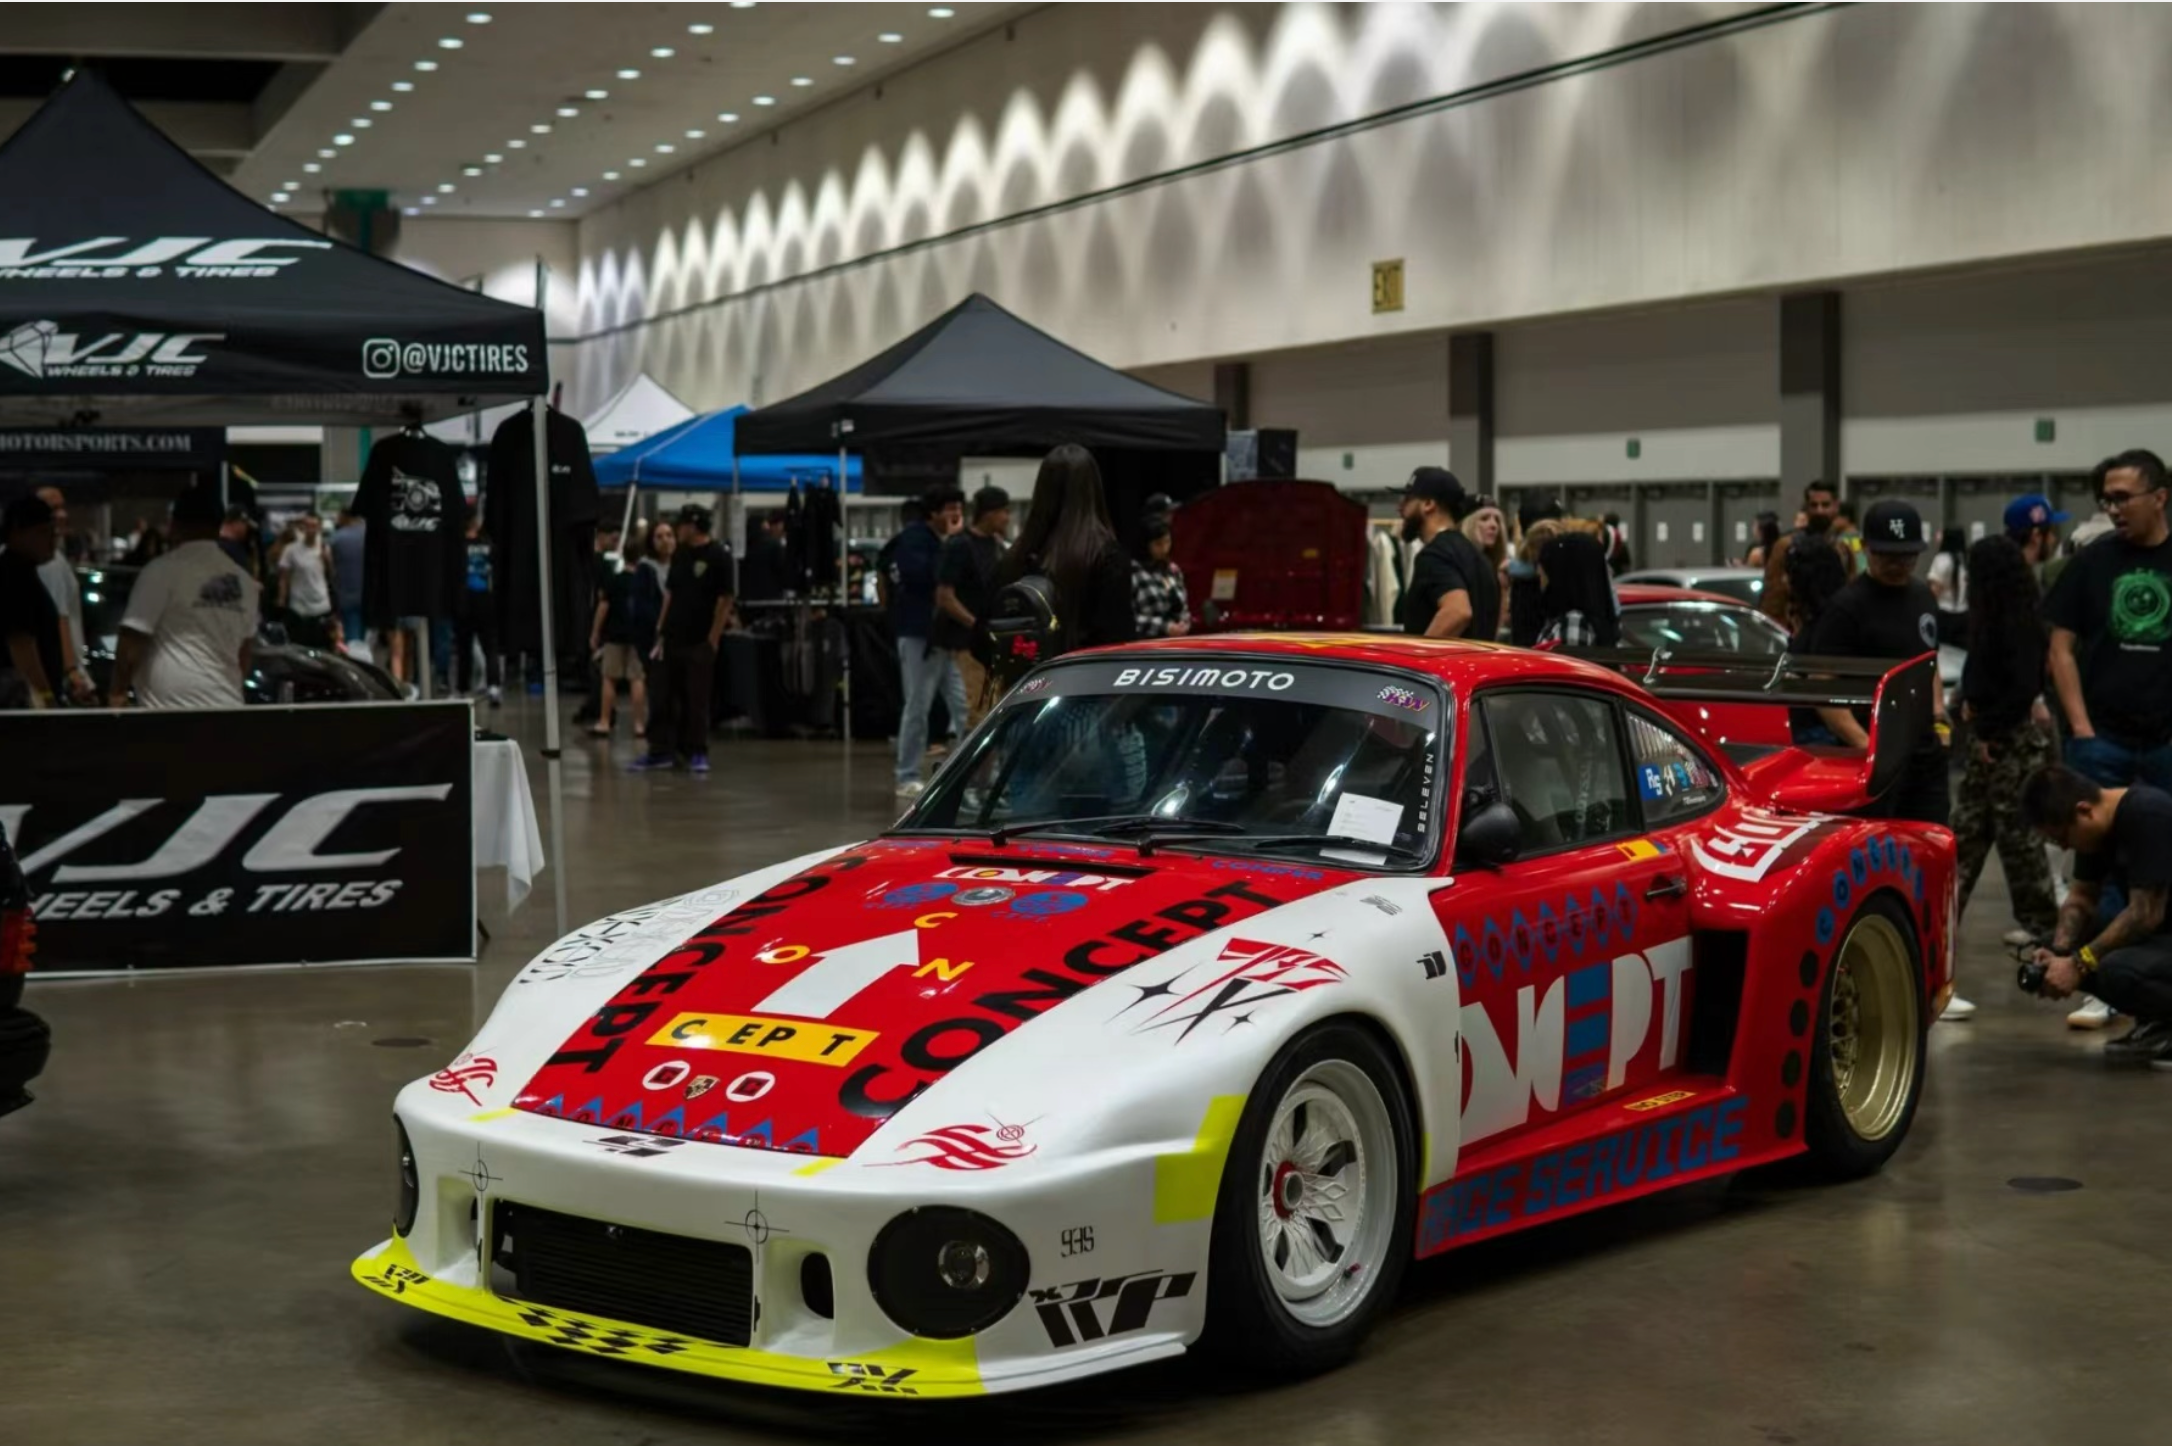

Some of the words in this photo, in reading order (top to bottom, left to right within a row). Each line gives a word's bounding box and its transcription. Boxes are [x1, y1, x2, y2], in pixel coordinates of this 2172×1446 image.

[175, 266, 278, 277] TIRES
[44, 333, 226, 363] VJC
[402, 342, 529, 374] @VJCTIRES
[47, 364, 123, 376] WHEELS
[146, 365, 197, 376] TIRES
[1113, 668, 1295, 691] BISIMOTO
[188, 887, 234, 915] &
[247, 880, 404, 912] TIRES
[838, 880, 1282, 1120] CONCEPT
